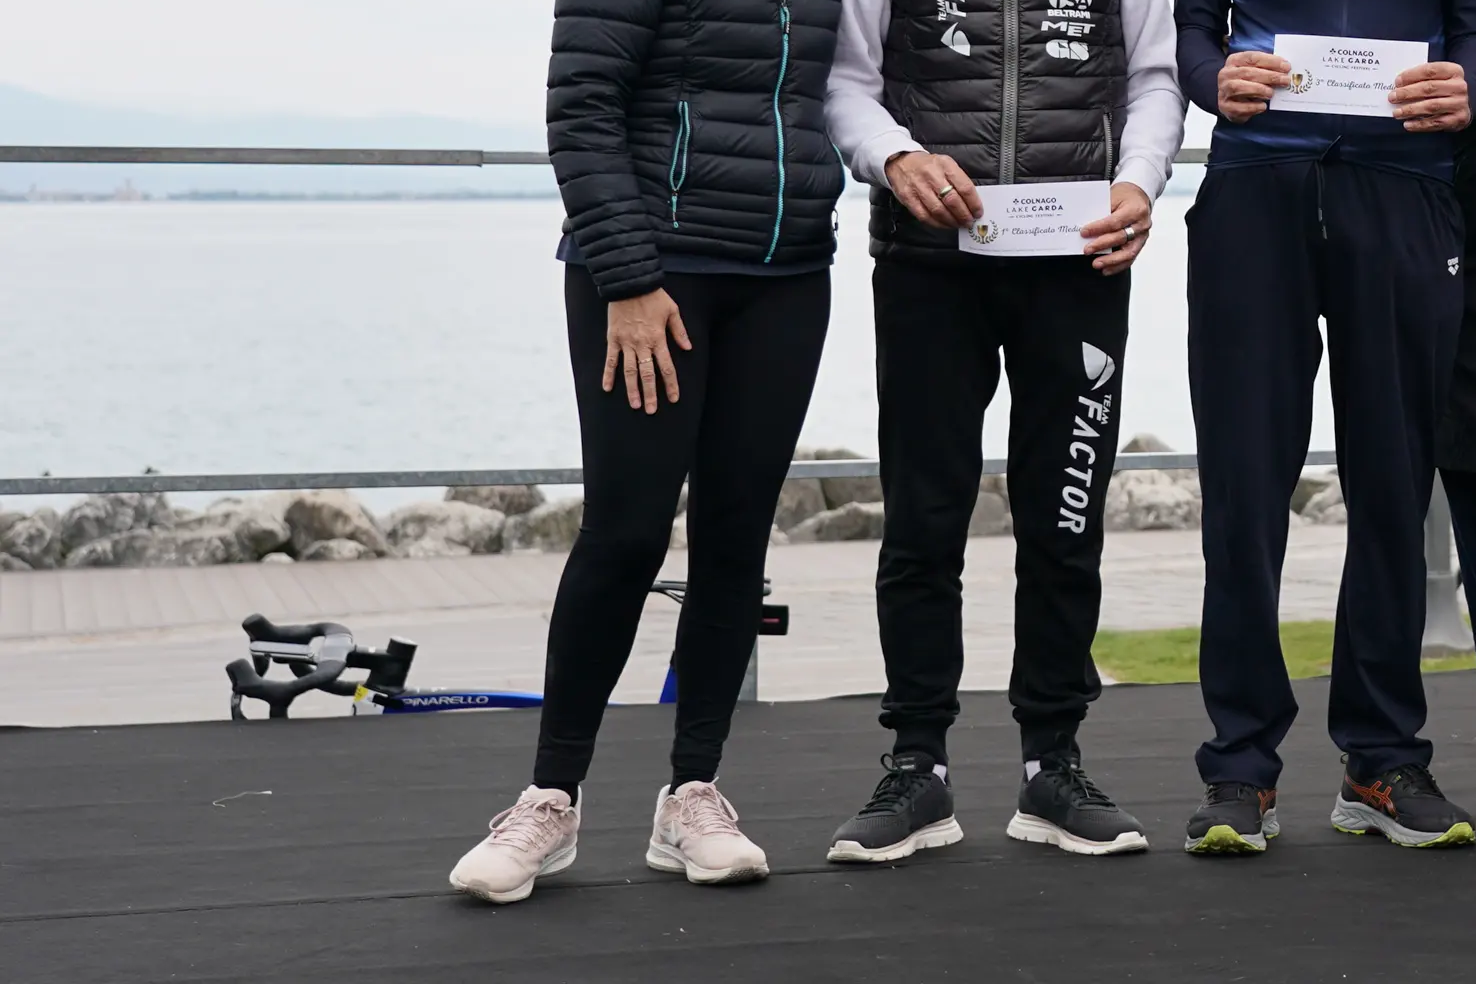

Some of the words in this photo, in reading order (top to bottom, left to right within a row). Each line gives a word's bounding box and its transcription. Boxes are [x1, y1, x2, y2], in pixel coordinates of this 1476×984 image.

[1047, 9, 1091, 19] BELTRAMI
[1041, 21, 1096, 36] MET
[1337, 49, 1374, 57] COLNAGO
[1327, 79, 1371, 90] Classificato
[1012, 226, 1055, 236] Classificato
[1101, 394, 1112, 424] TEAM
[1058, 395, 1102, 534] FACTOR
[402, 696, 489, 707] PINARELLO
